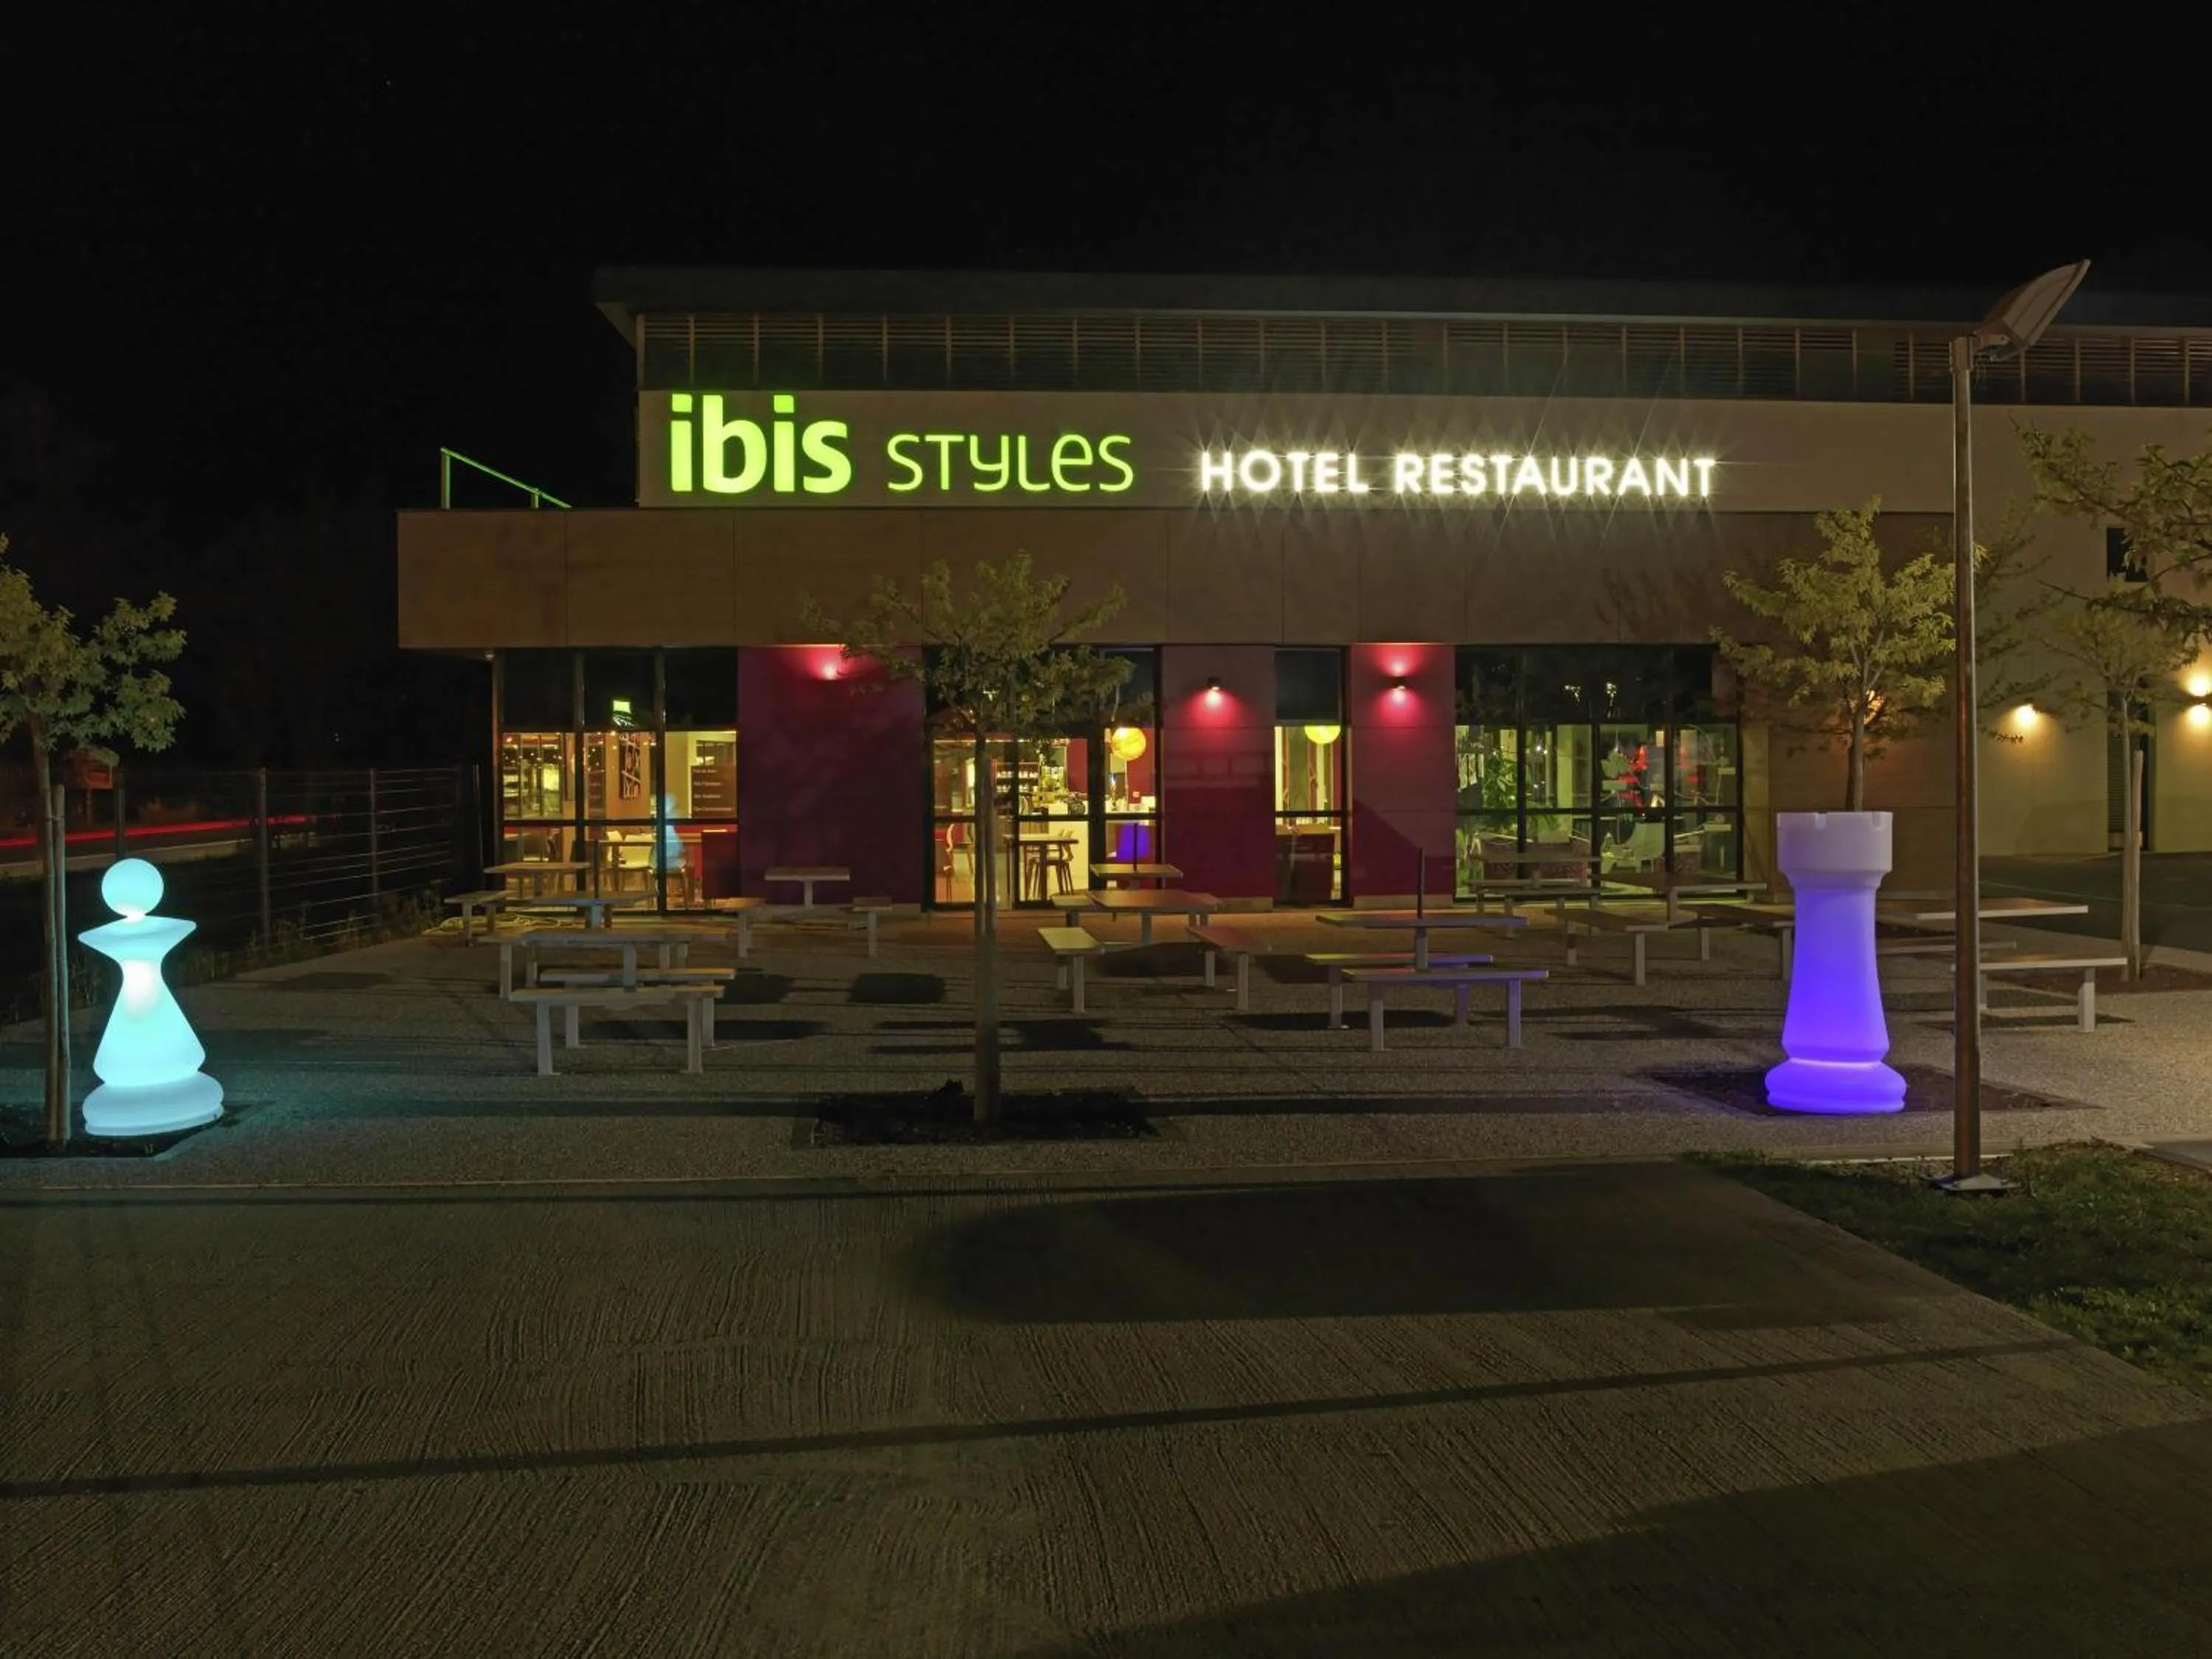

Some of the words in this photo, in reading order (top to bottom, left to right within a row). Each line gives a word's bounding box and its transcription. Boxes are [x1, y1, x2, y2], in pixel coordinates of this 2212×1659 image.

[670, 394, 852, 494] ibis
[1200, 449, 1369, 494] HOTEL
[1393, 452, 1717, 498] RESTAURANT
